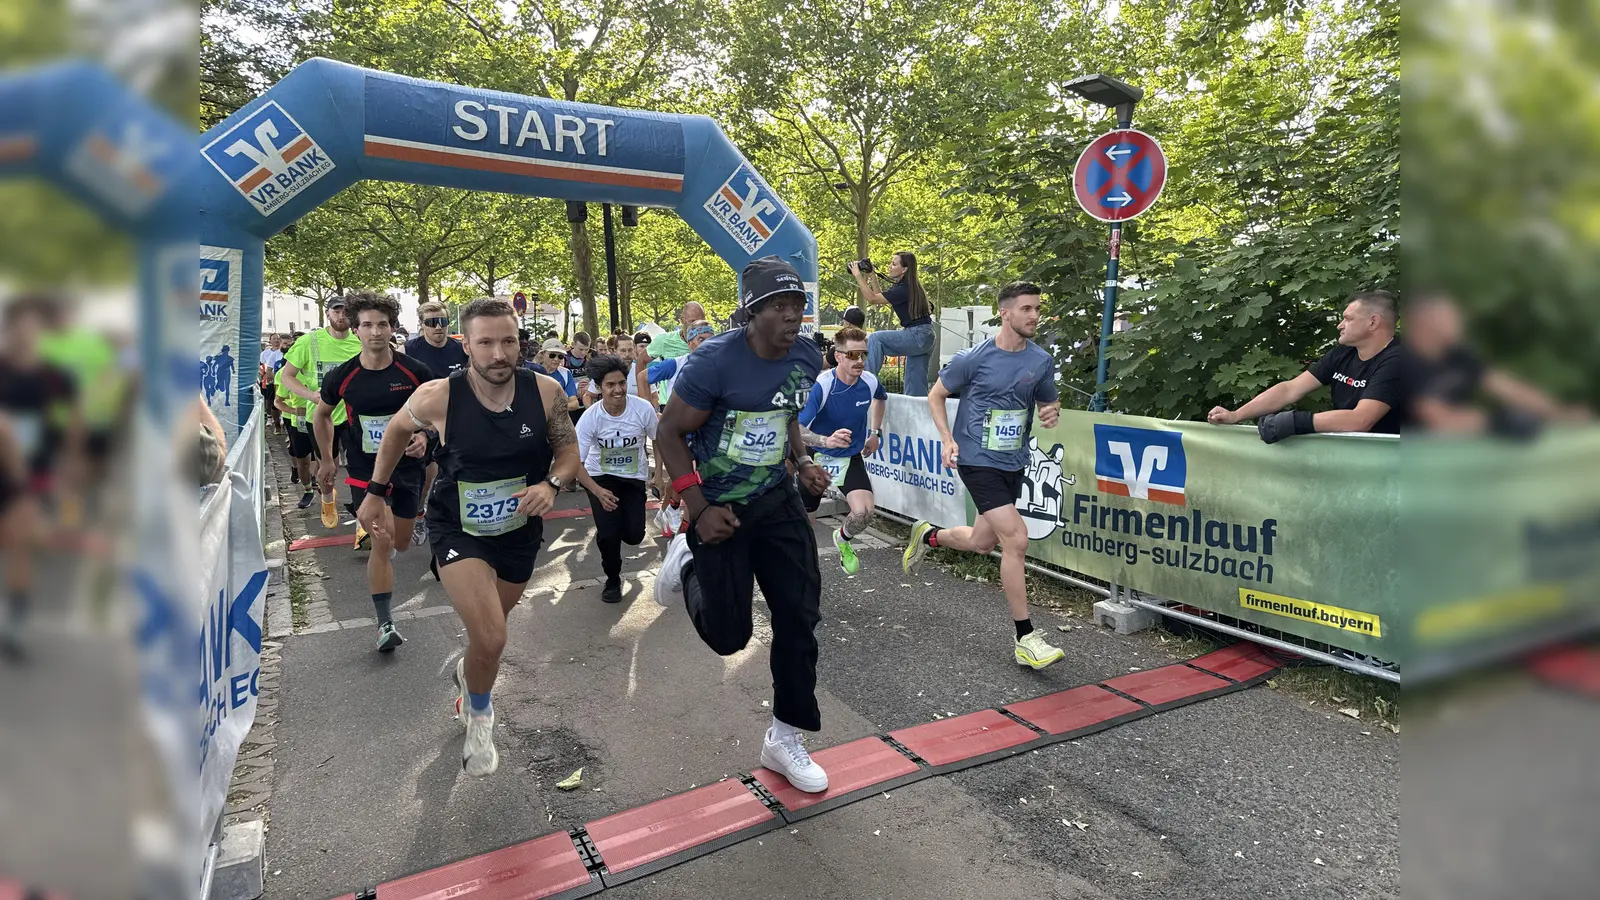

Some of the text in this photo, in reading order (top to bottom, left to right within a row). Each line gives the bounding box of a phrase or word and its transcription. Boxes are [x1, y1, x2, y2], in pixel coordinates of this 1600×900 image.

[452, 100, 614, 157] START
[249, 148, 326, 205] VR BANK
[263, 161, 331, 212] AMBERG-SULZBACH EG
[707, 203, 749, 247] AMBERG-SULZBACH
[713, 194, 763, 248] VR BANK
[743, 431, 776, 447] 542
[995, 425, 1022, 436] 1450
[605, 456, 632, 464] 2196
[466, 497, 519, 519] 2373
[941, 480, 955, 496] EG
[1073, 494, 1278, 556] Firmenlauf
[1062, 529, 1275, 584] amberg-sulzbach
[1245, 594, 1374, 633] firmenlauf.bayern
